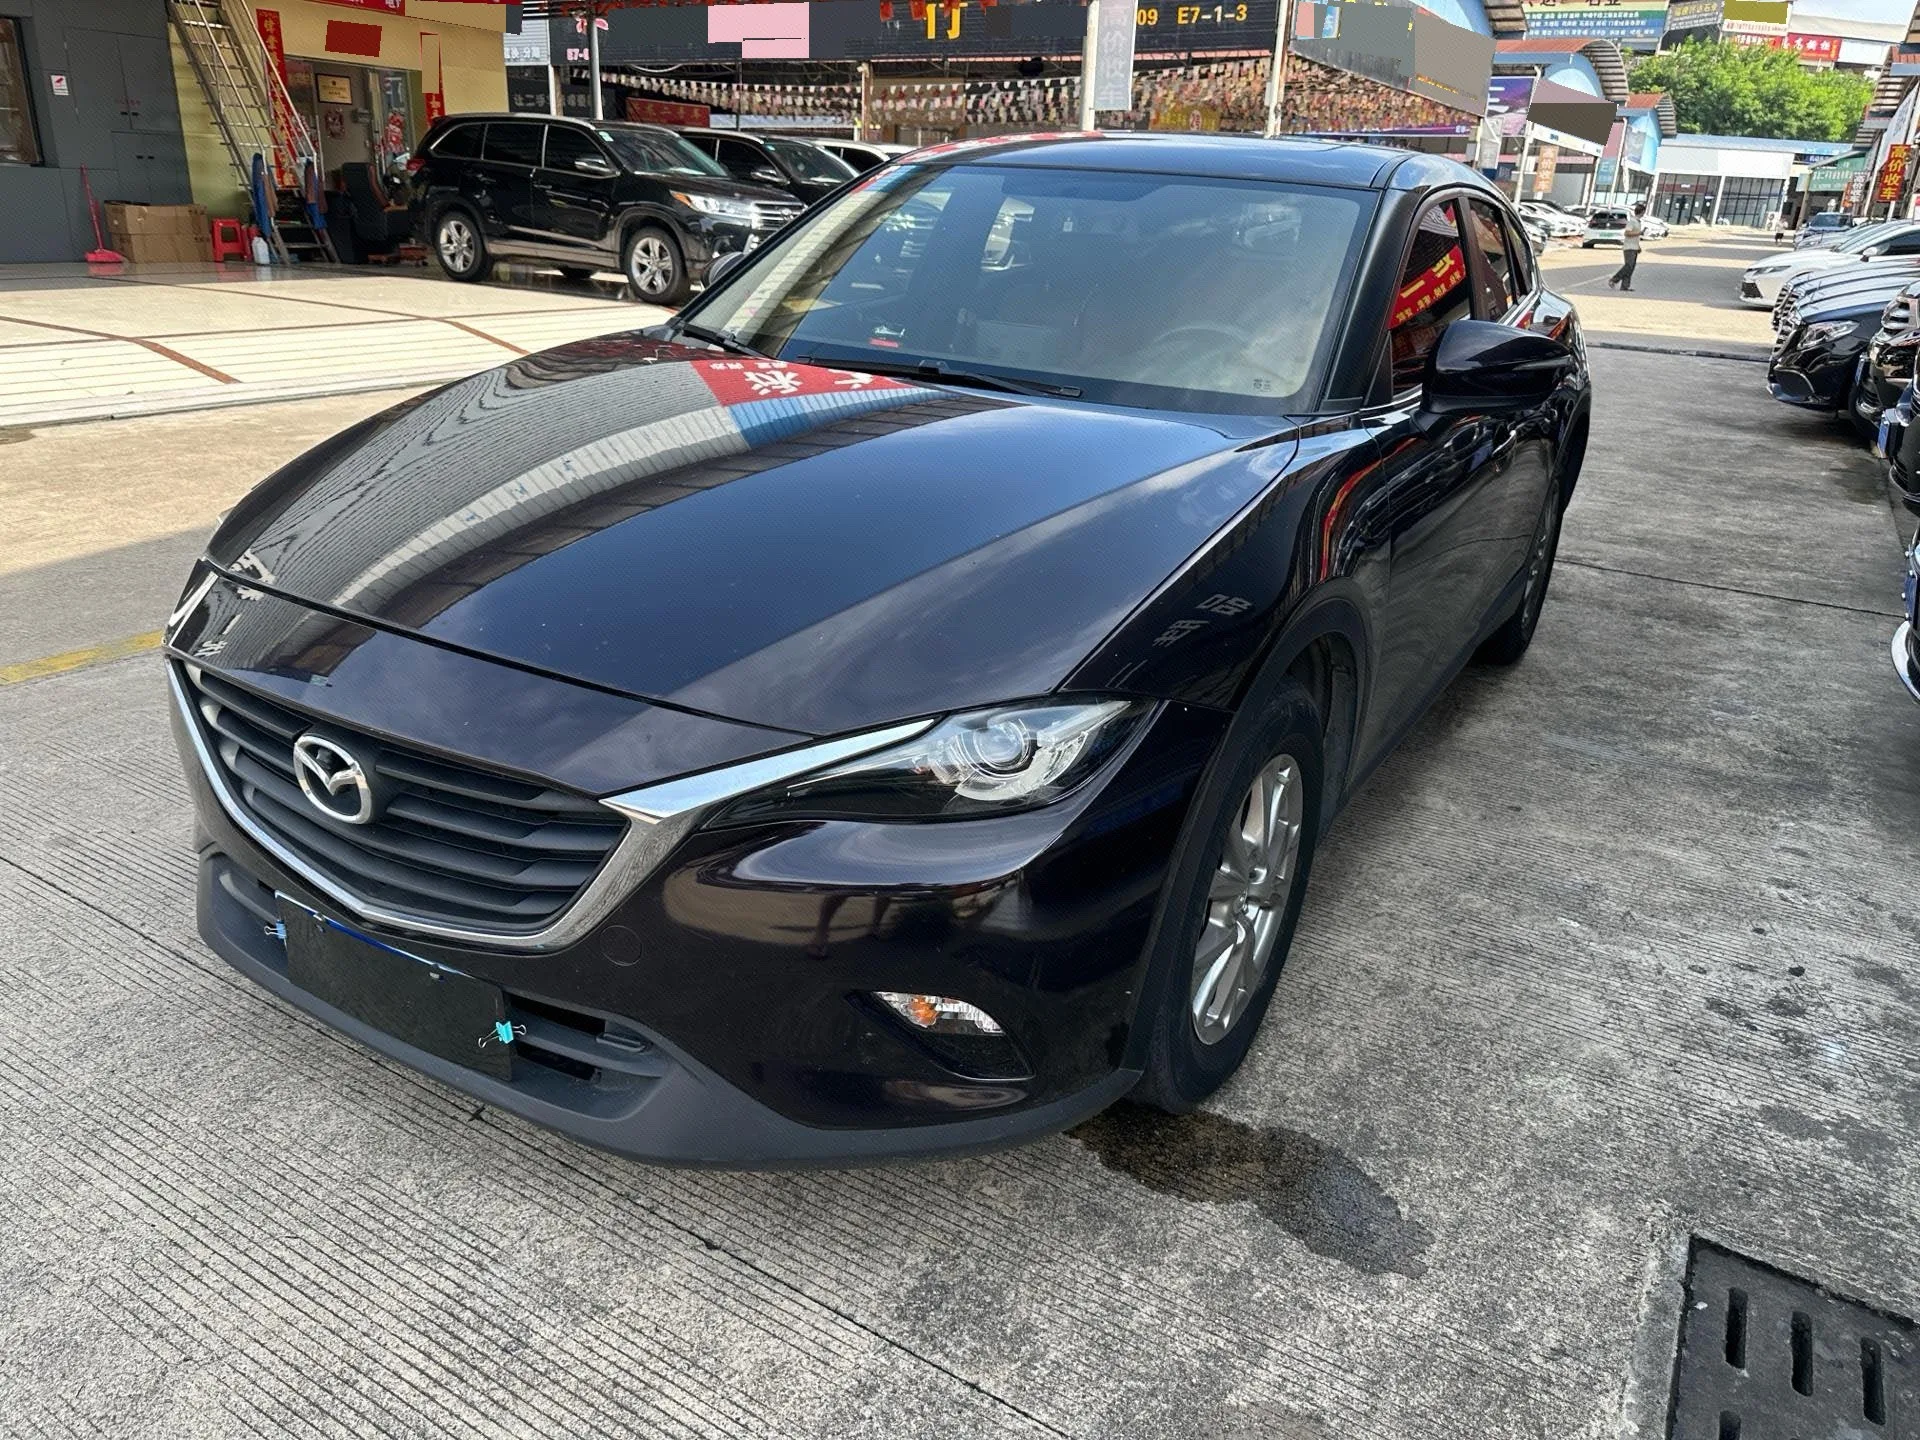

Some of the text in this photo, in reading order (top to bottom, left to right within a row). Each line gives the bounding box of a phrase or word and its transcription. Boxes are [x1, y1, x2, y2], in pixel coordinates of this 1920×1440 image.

[1177, 4, 1248, 25] E7-1-3
[1098, 2, 1127, 104] 高价收车
[1880, 145, 1907, 200] 高价收车
